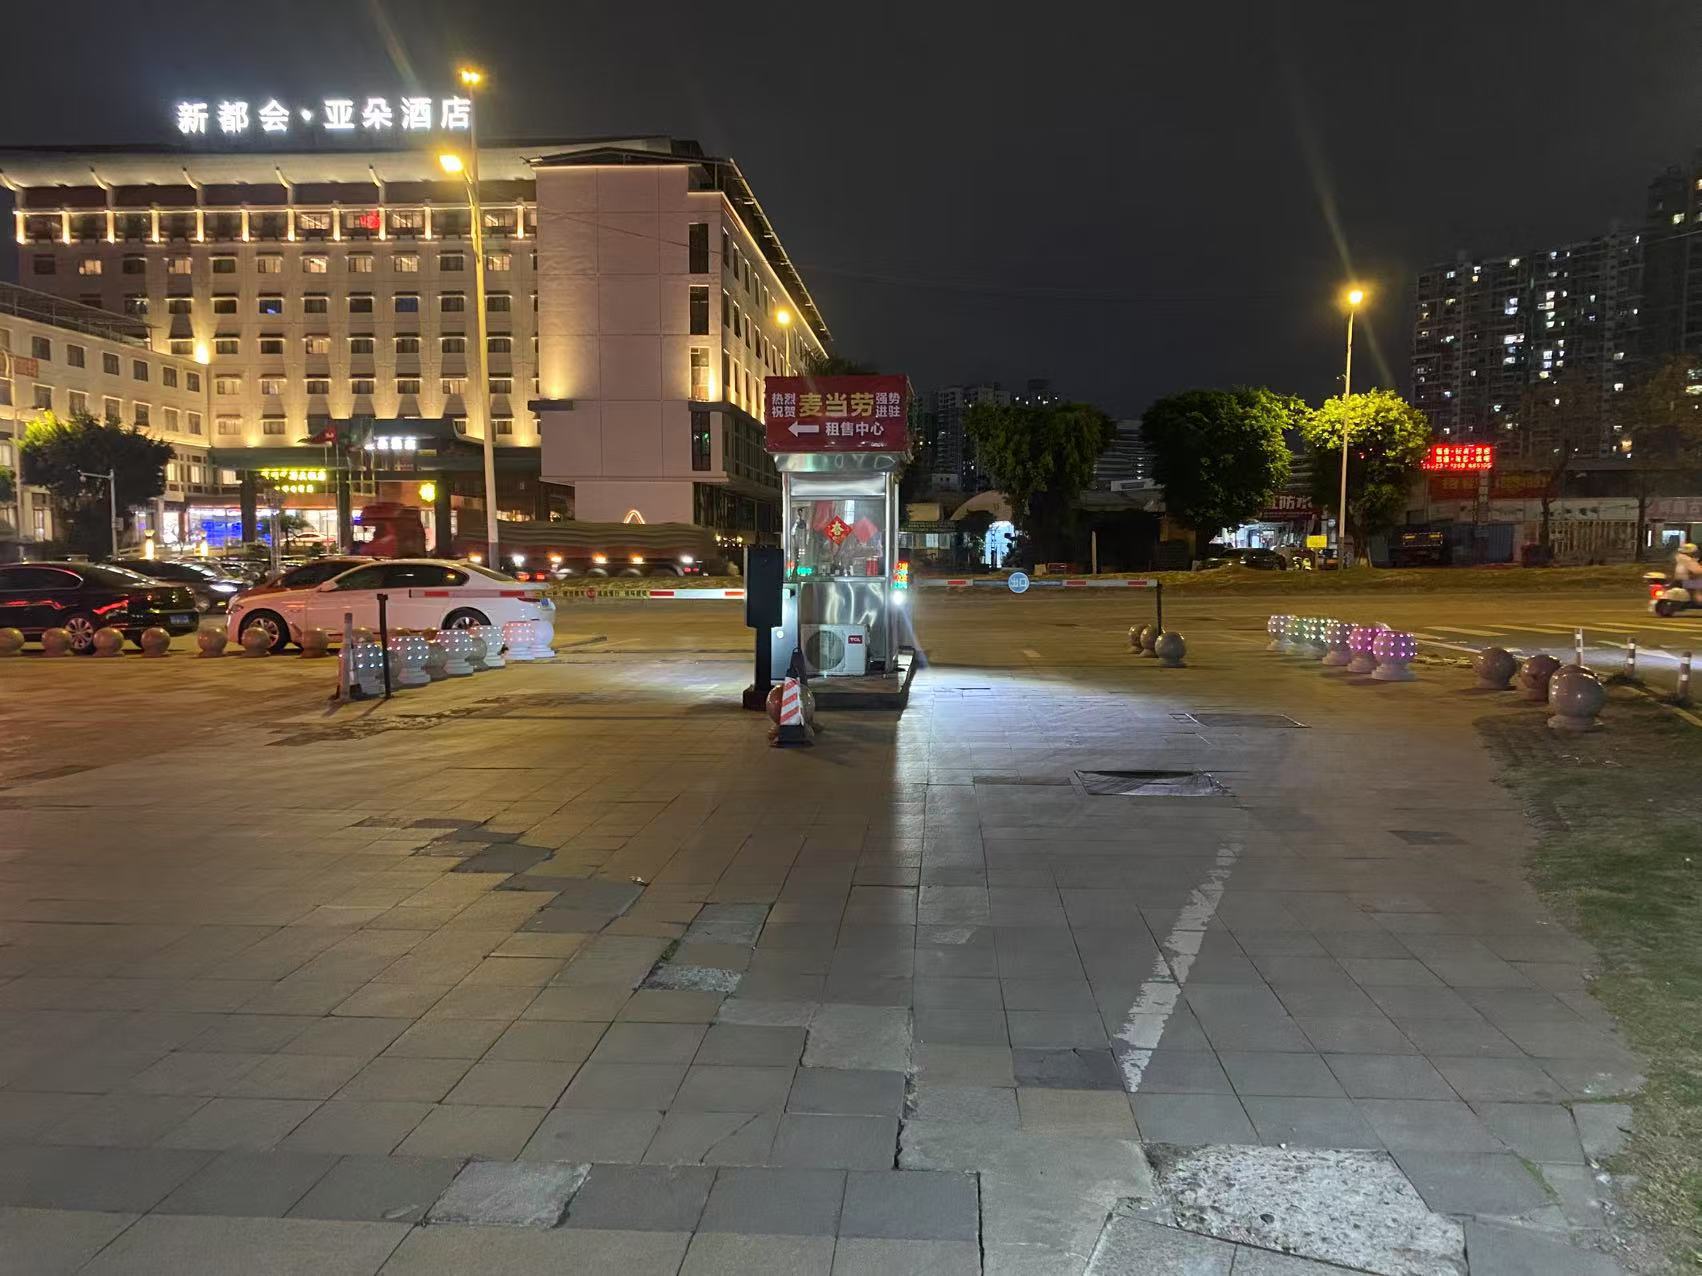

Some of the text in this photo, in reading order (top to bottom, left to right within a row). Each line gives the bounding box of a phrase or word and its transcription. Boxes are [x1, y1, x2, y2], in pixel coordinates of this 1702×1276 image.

[771, 393, 796, 405] 热烈
[799, 392, 874, 417] 麦当劳
[875, 392, 900, 405] 强势
[771, 405, 796, 418] 祝贺
[875, 405, 900, 418] 进驻
[825, 421, 884, 436] 租售中心
